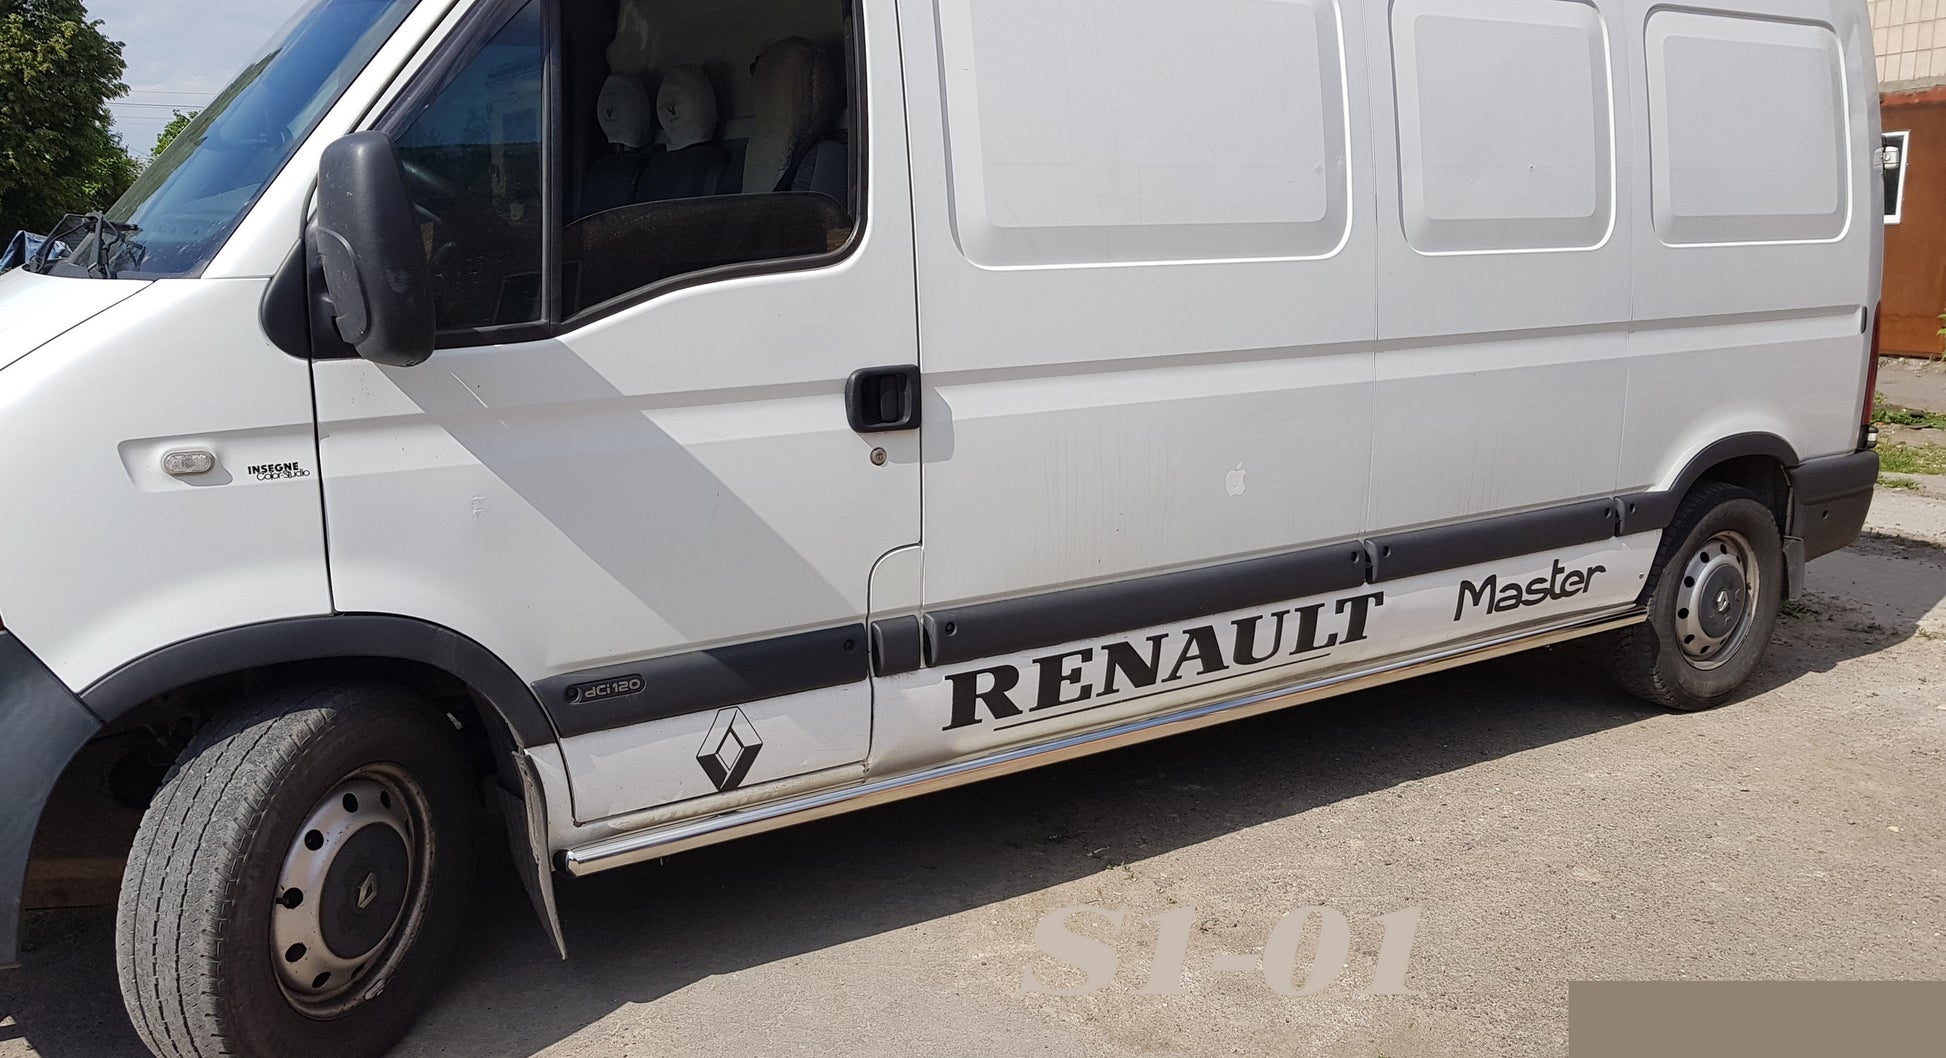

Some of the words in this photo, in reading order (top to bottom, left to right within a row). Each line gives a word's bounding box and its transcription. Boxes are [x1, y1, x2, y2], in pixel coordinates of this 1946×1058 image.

[248, 462, 298, 475] INSEGNE
[1454, 559, 1607, 621] Master
[942, 590, 1384, 731] RENAULT
[612, 679, 641, 693] 120
